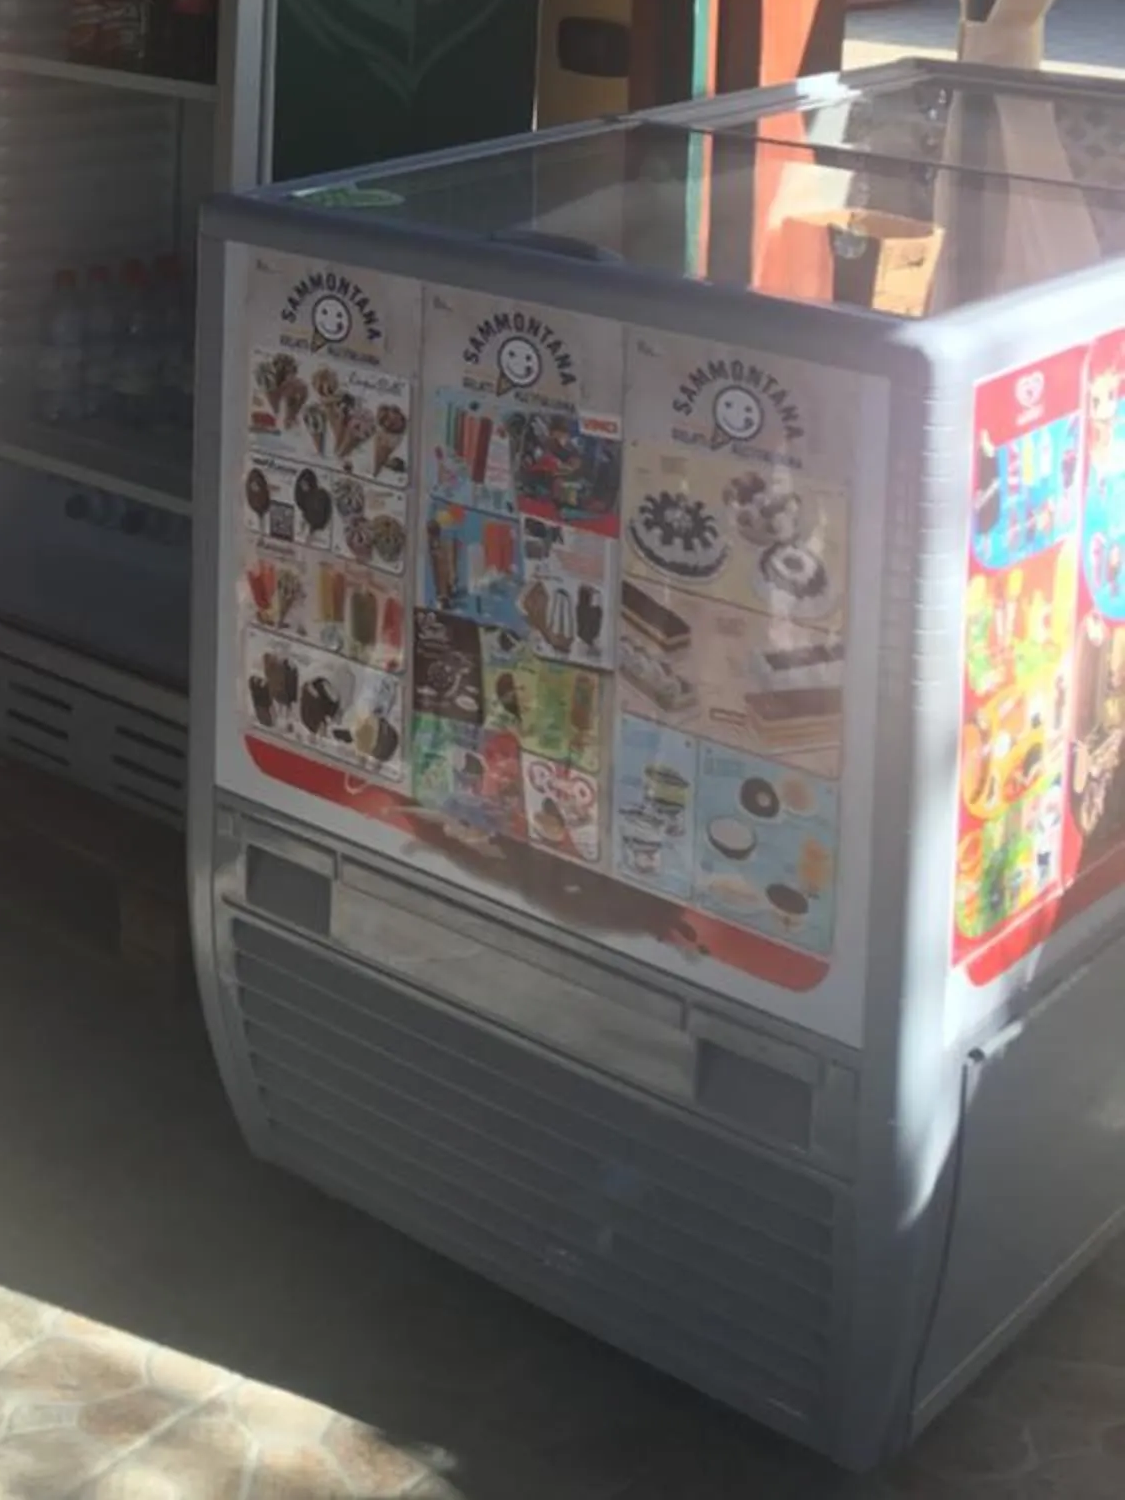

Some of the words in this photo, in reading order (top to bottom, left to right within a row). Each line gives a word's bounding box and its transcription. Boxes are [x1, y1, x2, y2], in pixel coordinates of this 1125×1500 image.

[280, 271, 383, 341] SAMMONTANA
[462, 311, 577, 386] SAMMONTANA
[671, 359, 805, 440] SAMMONTANA
